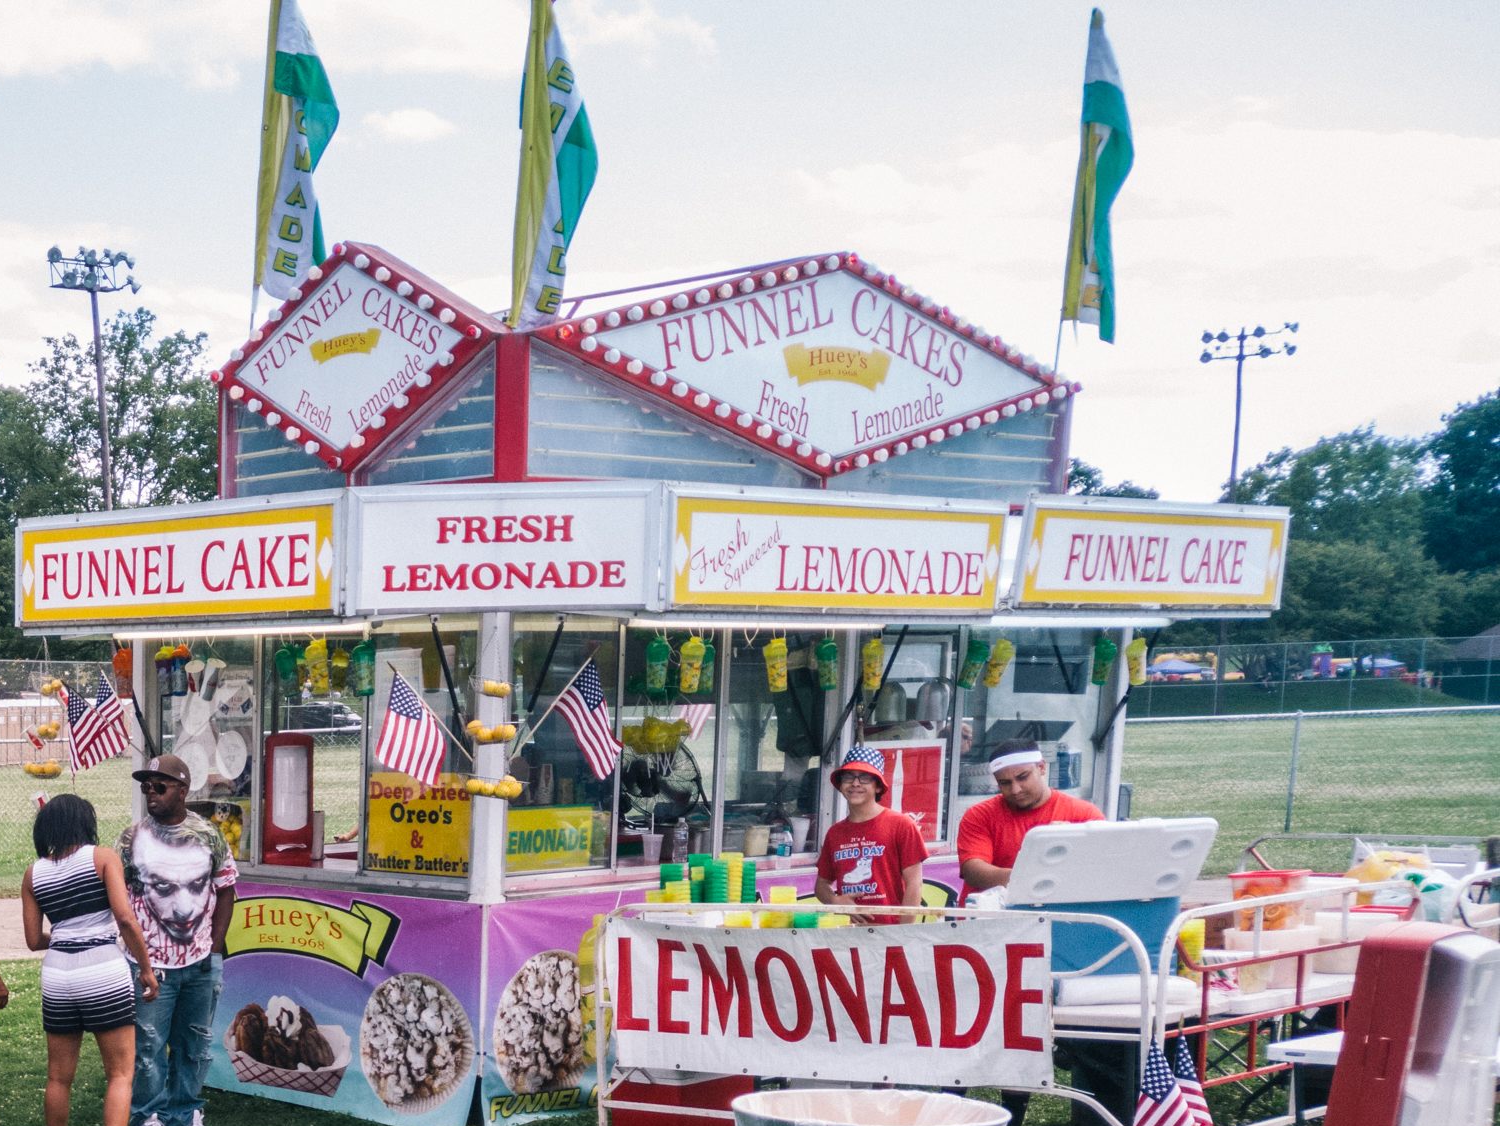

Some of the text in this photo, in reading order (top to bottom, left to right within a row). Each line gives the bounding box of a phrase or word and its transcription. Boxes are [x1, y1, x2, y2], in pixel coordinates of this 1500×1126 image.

[255, 279, 443, 386] FUNNEL CAKES
[323, 333, 366, 353] Huey's
[656, 280, 967, 387] FUNNEL CAKES
[809, 348, 868, 369] Huey's
[295, 354, 424, 434] Fresh Lemonade
[756, 380, 944, 445] Fresh Lemonade
[436, 515, 574, 544] FRESH
[41, 533, 310, 600] FUNNEL CAKE
[690, 517, 750, 585] Fresh
[723, 519, 782, 591] Squeezed
[1063, 533, 1248, 585] FUNNEL CAKE
[382, 560, 626, 592] LEMONADE
[775, 544, 984, 596] LEMONADE
[370, 781, 414, 804] Deep
[389, 802, 453, 824] Oreo's
[410, 830, 423, 849] &
[862, 845, 886, 857] DAY
[367, 853, 469, 872] Nutter Butter's
[242, 903, 343, 940] Huey's
[259, 933, 325, 950] Est. 1968
[616, 937, 1045, 1052] LEMONADE
[490, 1087, 581, 1122] FUNNEL
